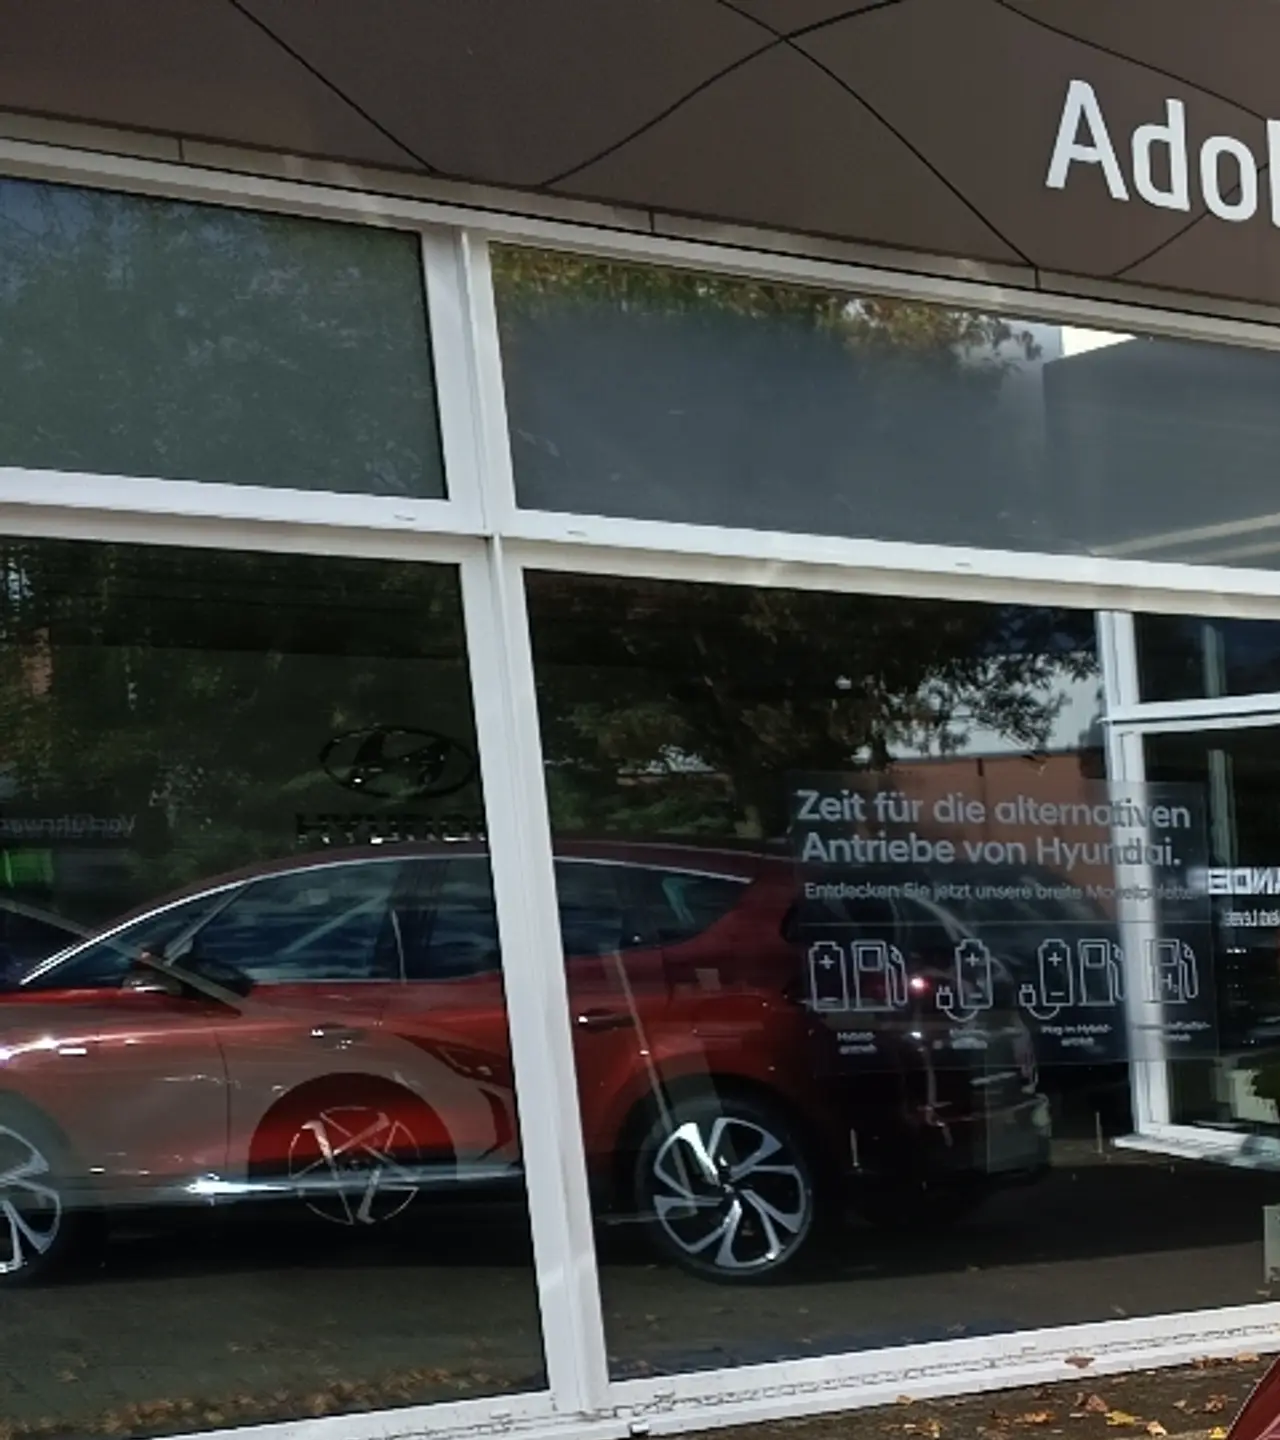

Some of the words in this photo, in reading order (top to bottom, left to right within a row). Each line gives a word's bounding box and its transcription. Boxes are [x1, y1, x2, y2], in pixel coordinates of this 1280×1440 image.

[796, 789, 867, 823] Zeit
[873, 790, 923, 824] für
[933, 793, 986, 825] die
[994, 796, 1192, 829] alternativen
[801, 831, 955, 864] Antriebe
[962, 840, 1026, 866] von
[1037, 836, 1181, 870] Hyundai.
